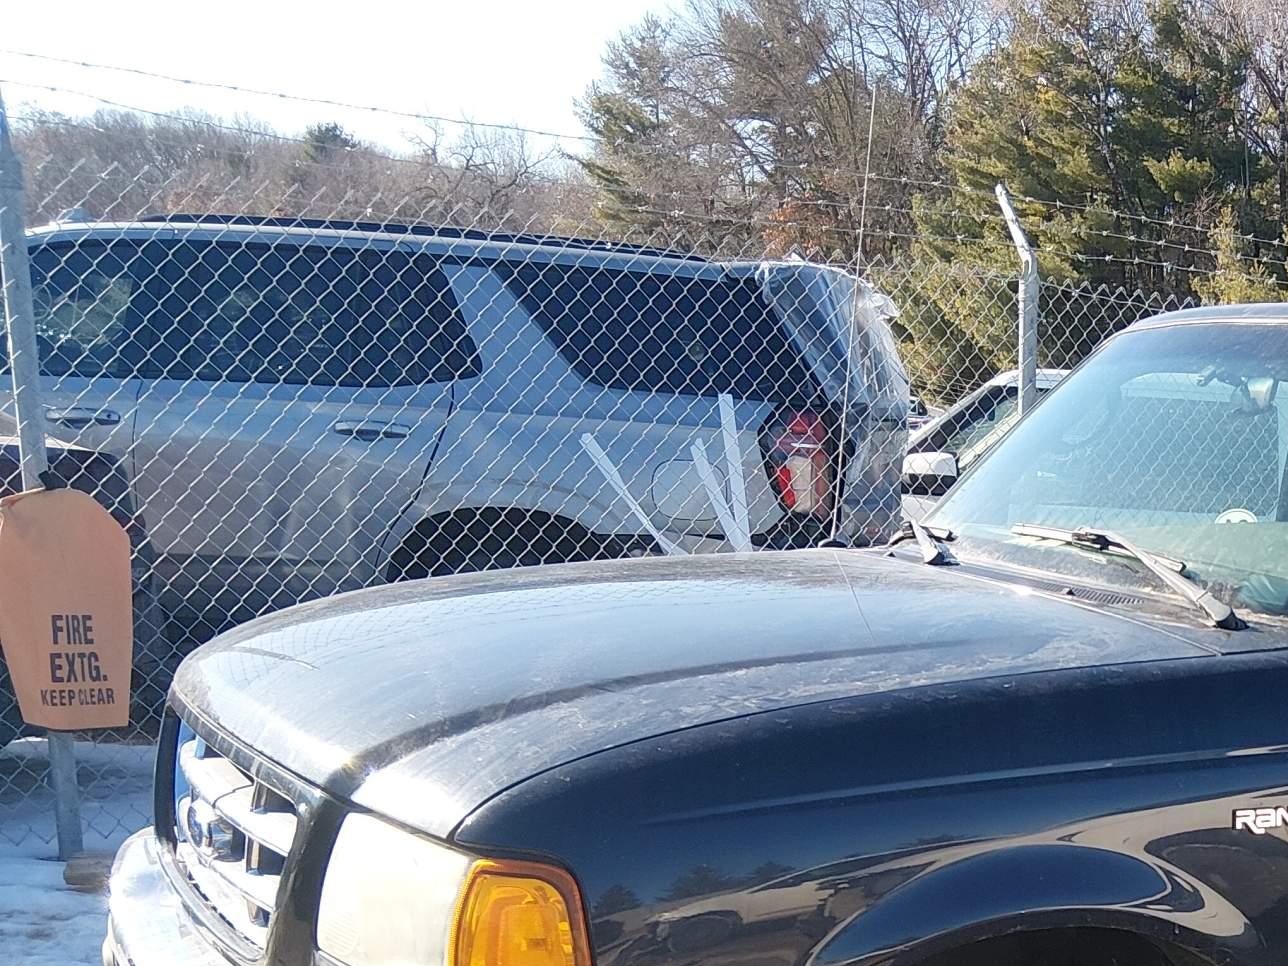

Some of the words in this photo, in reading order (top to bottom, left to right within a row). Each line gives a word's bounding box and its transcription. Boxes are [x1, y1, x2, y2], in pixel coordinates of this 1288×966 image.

[51, 614, 95, 645] FIRE
[49, 652, 108, 683] EXTG.
[40, 689, 76, 707] KEEP
[77, 687, 115, 706] CLEAR
